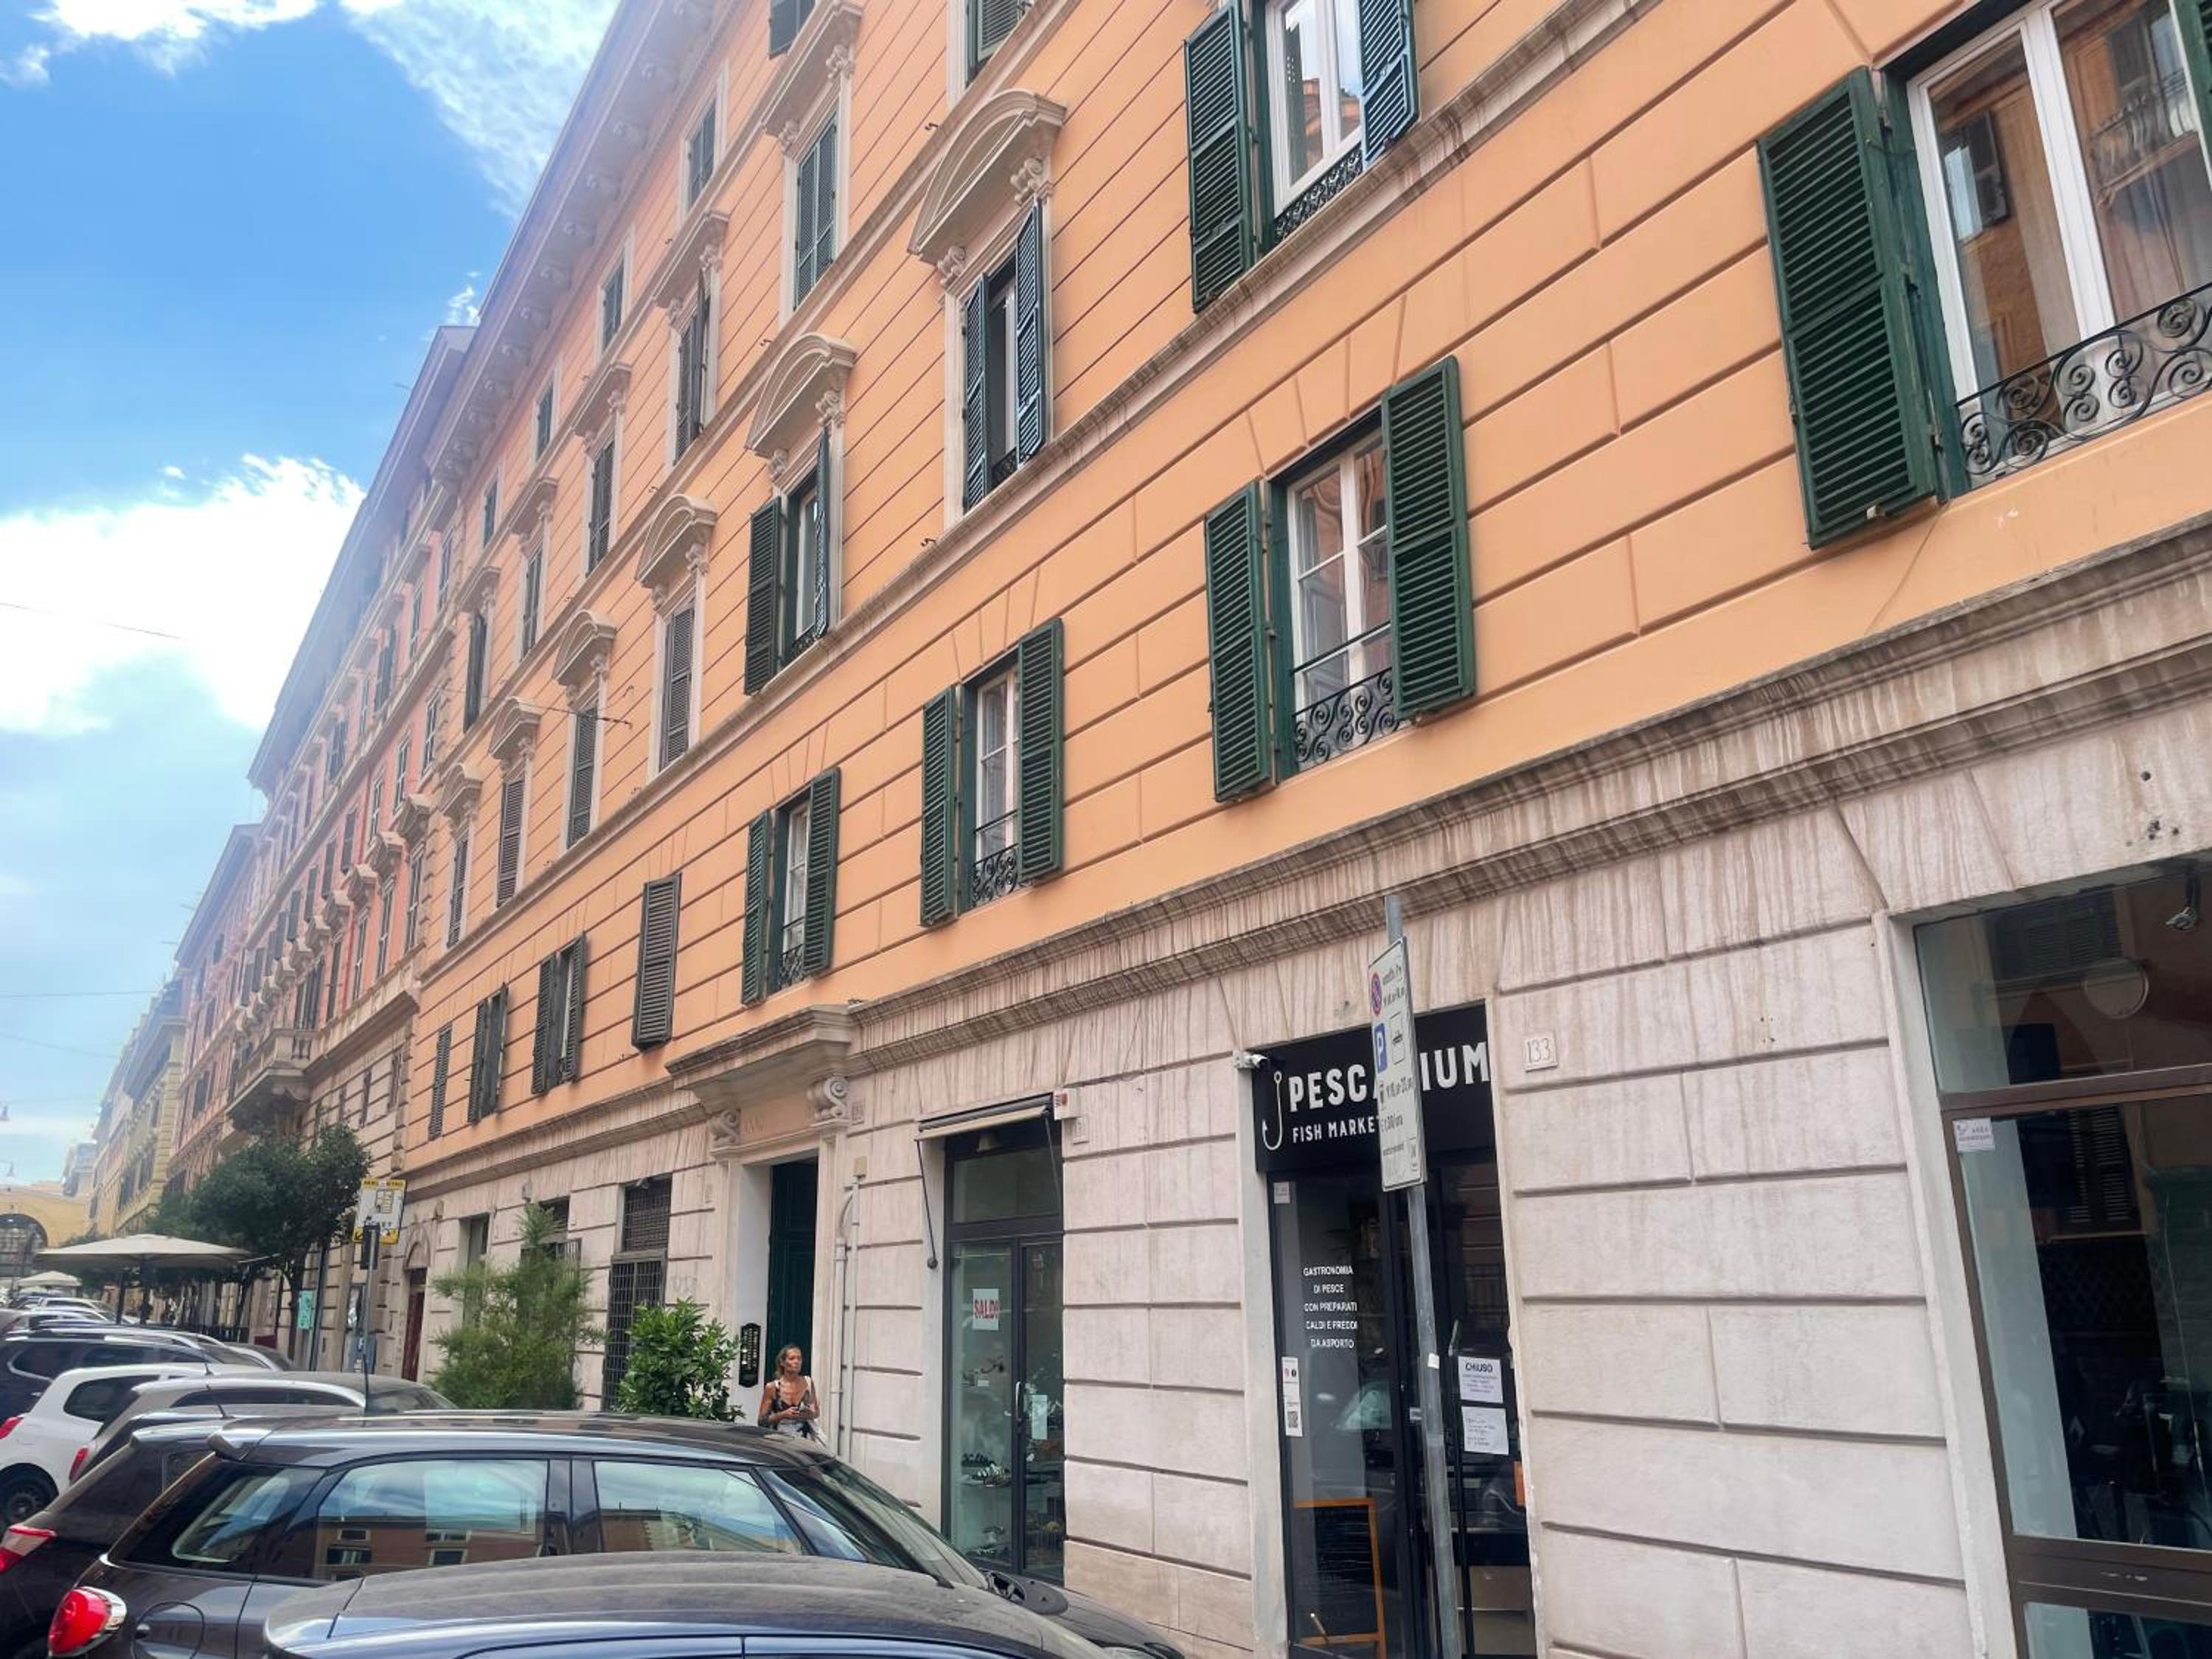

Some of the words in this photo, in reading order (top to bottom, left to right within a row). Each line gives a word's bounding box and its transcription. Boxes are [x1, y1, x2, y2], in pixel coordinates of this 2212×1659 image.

[1526, 1037, 1551, 1064] 133
[1289, 1040, 1490, 1113] PESCIUM
[1293, 1123, 1323, 1143] FISH
[1328, 1115, 1380, 1139] MARKE
[1302, 1265, 1354, 1276] GASTRONOMIA
[1313, 1284, 1321, 1294] DI
[1322, 1283, 1345, 1294] PESCE
[1304, 1302, 1319, 1312] CON
[1319, 1301, 1357, 1312] PREPARATI
[1306, 1321, 1326, 1329] CALDI
[1326, 1321, 1332, 1329] E
[1332, 1321, 1358, 1329] FREDDI
[1310, 1338, 1321, 1348] DA
[1321, 1338, 1355, 1349] ASPORTO
[1465, 1362, 1494, 1373] CHIUSO
